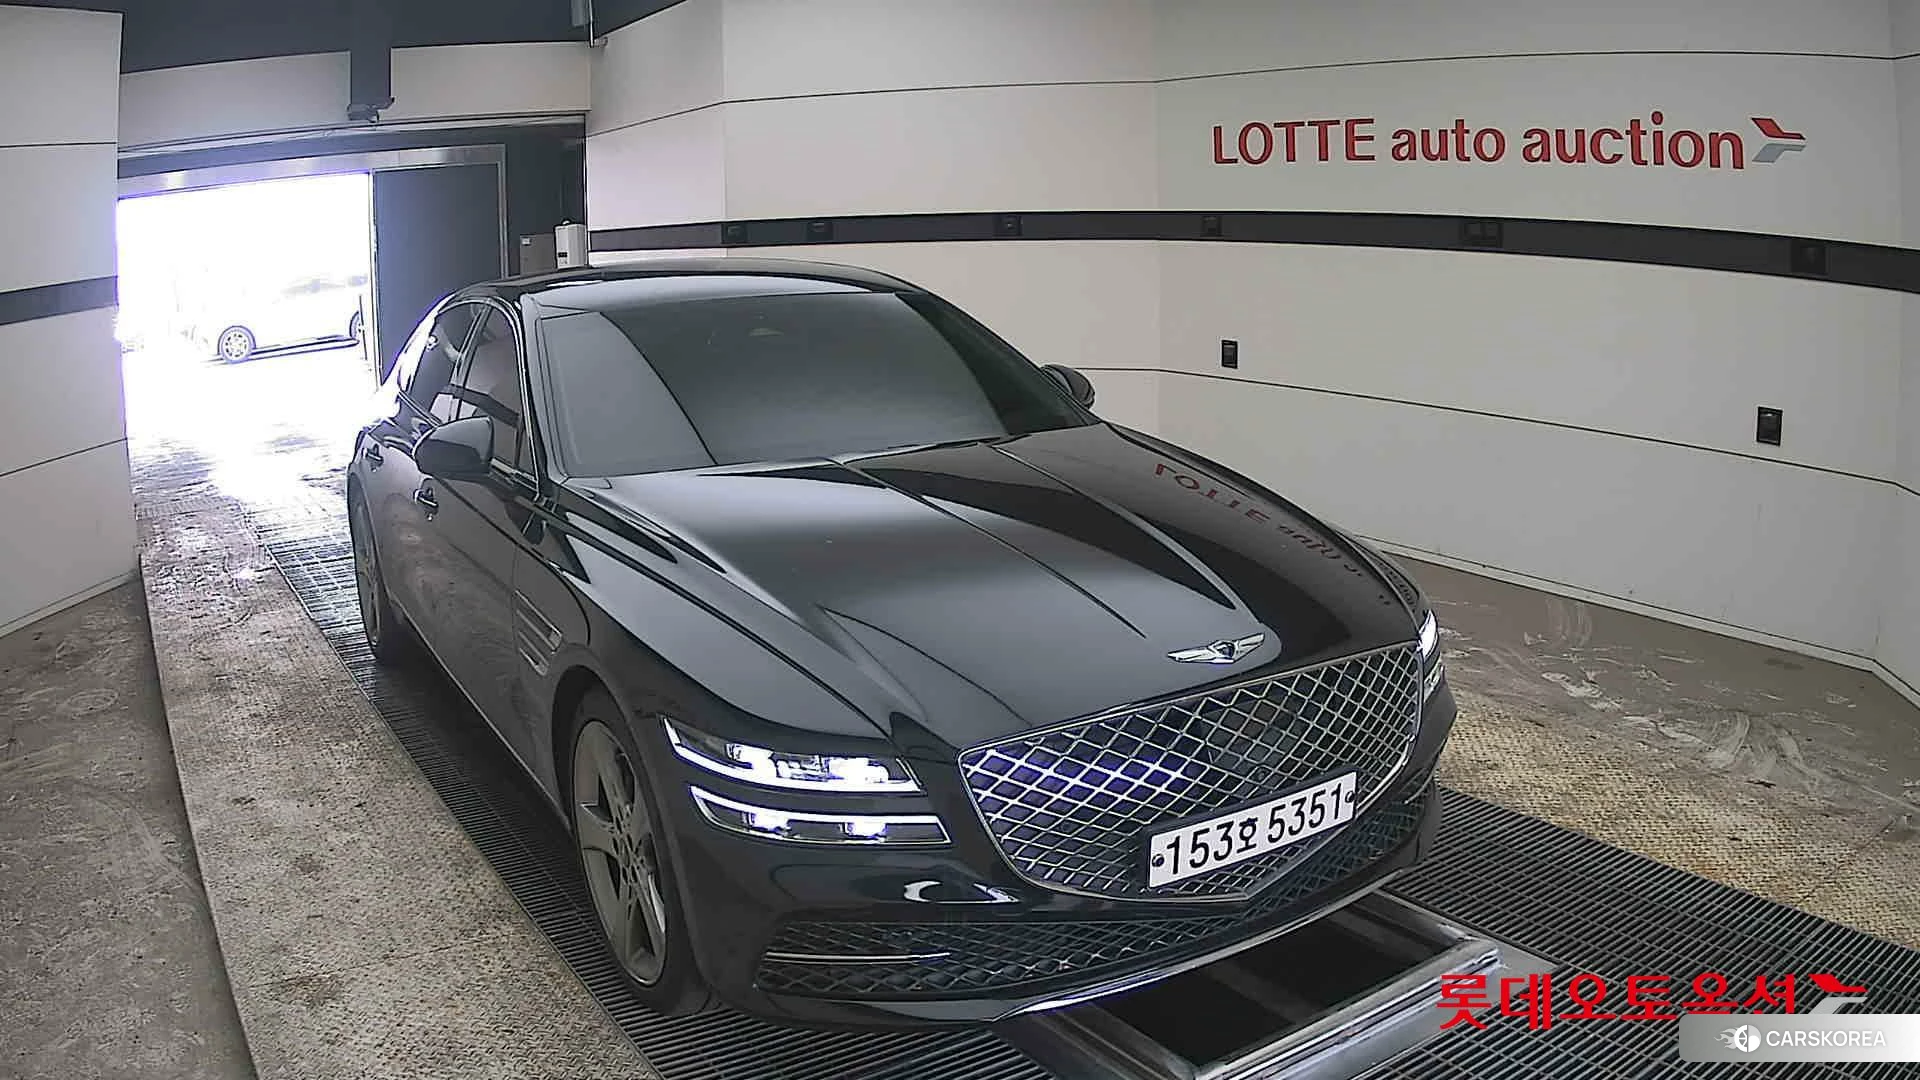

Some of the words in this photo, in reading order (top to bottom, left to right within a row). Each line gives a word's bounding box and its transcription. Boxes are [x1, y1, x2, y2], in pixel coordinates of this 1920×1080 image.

[1213, 118, 1376, 165] LOTTE
[1391, 118, 1505, 163] auto
[1522, 111, 1744, 170] auction
[1167, 817, 1260, 875] 153호
[1267, 782, 1342, 844] 5351
